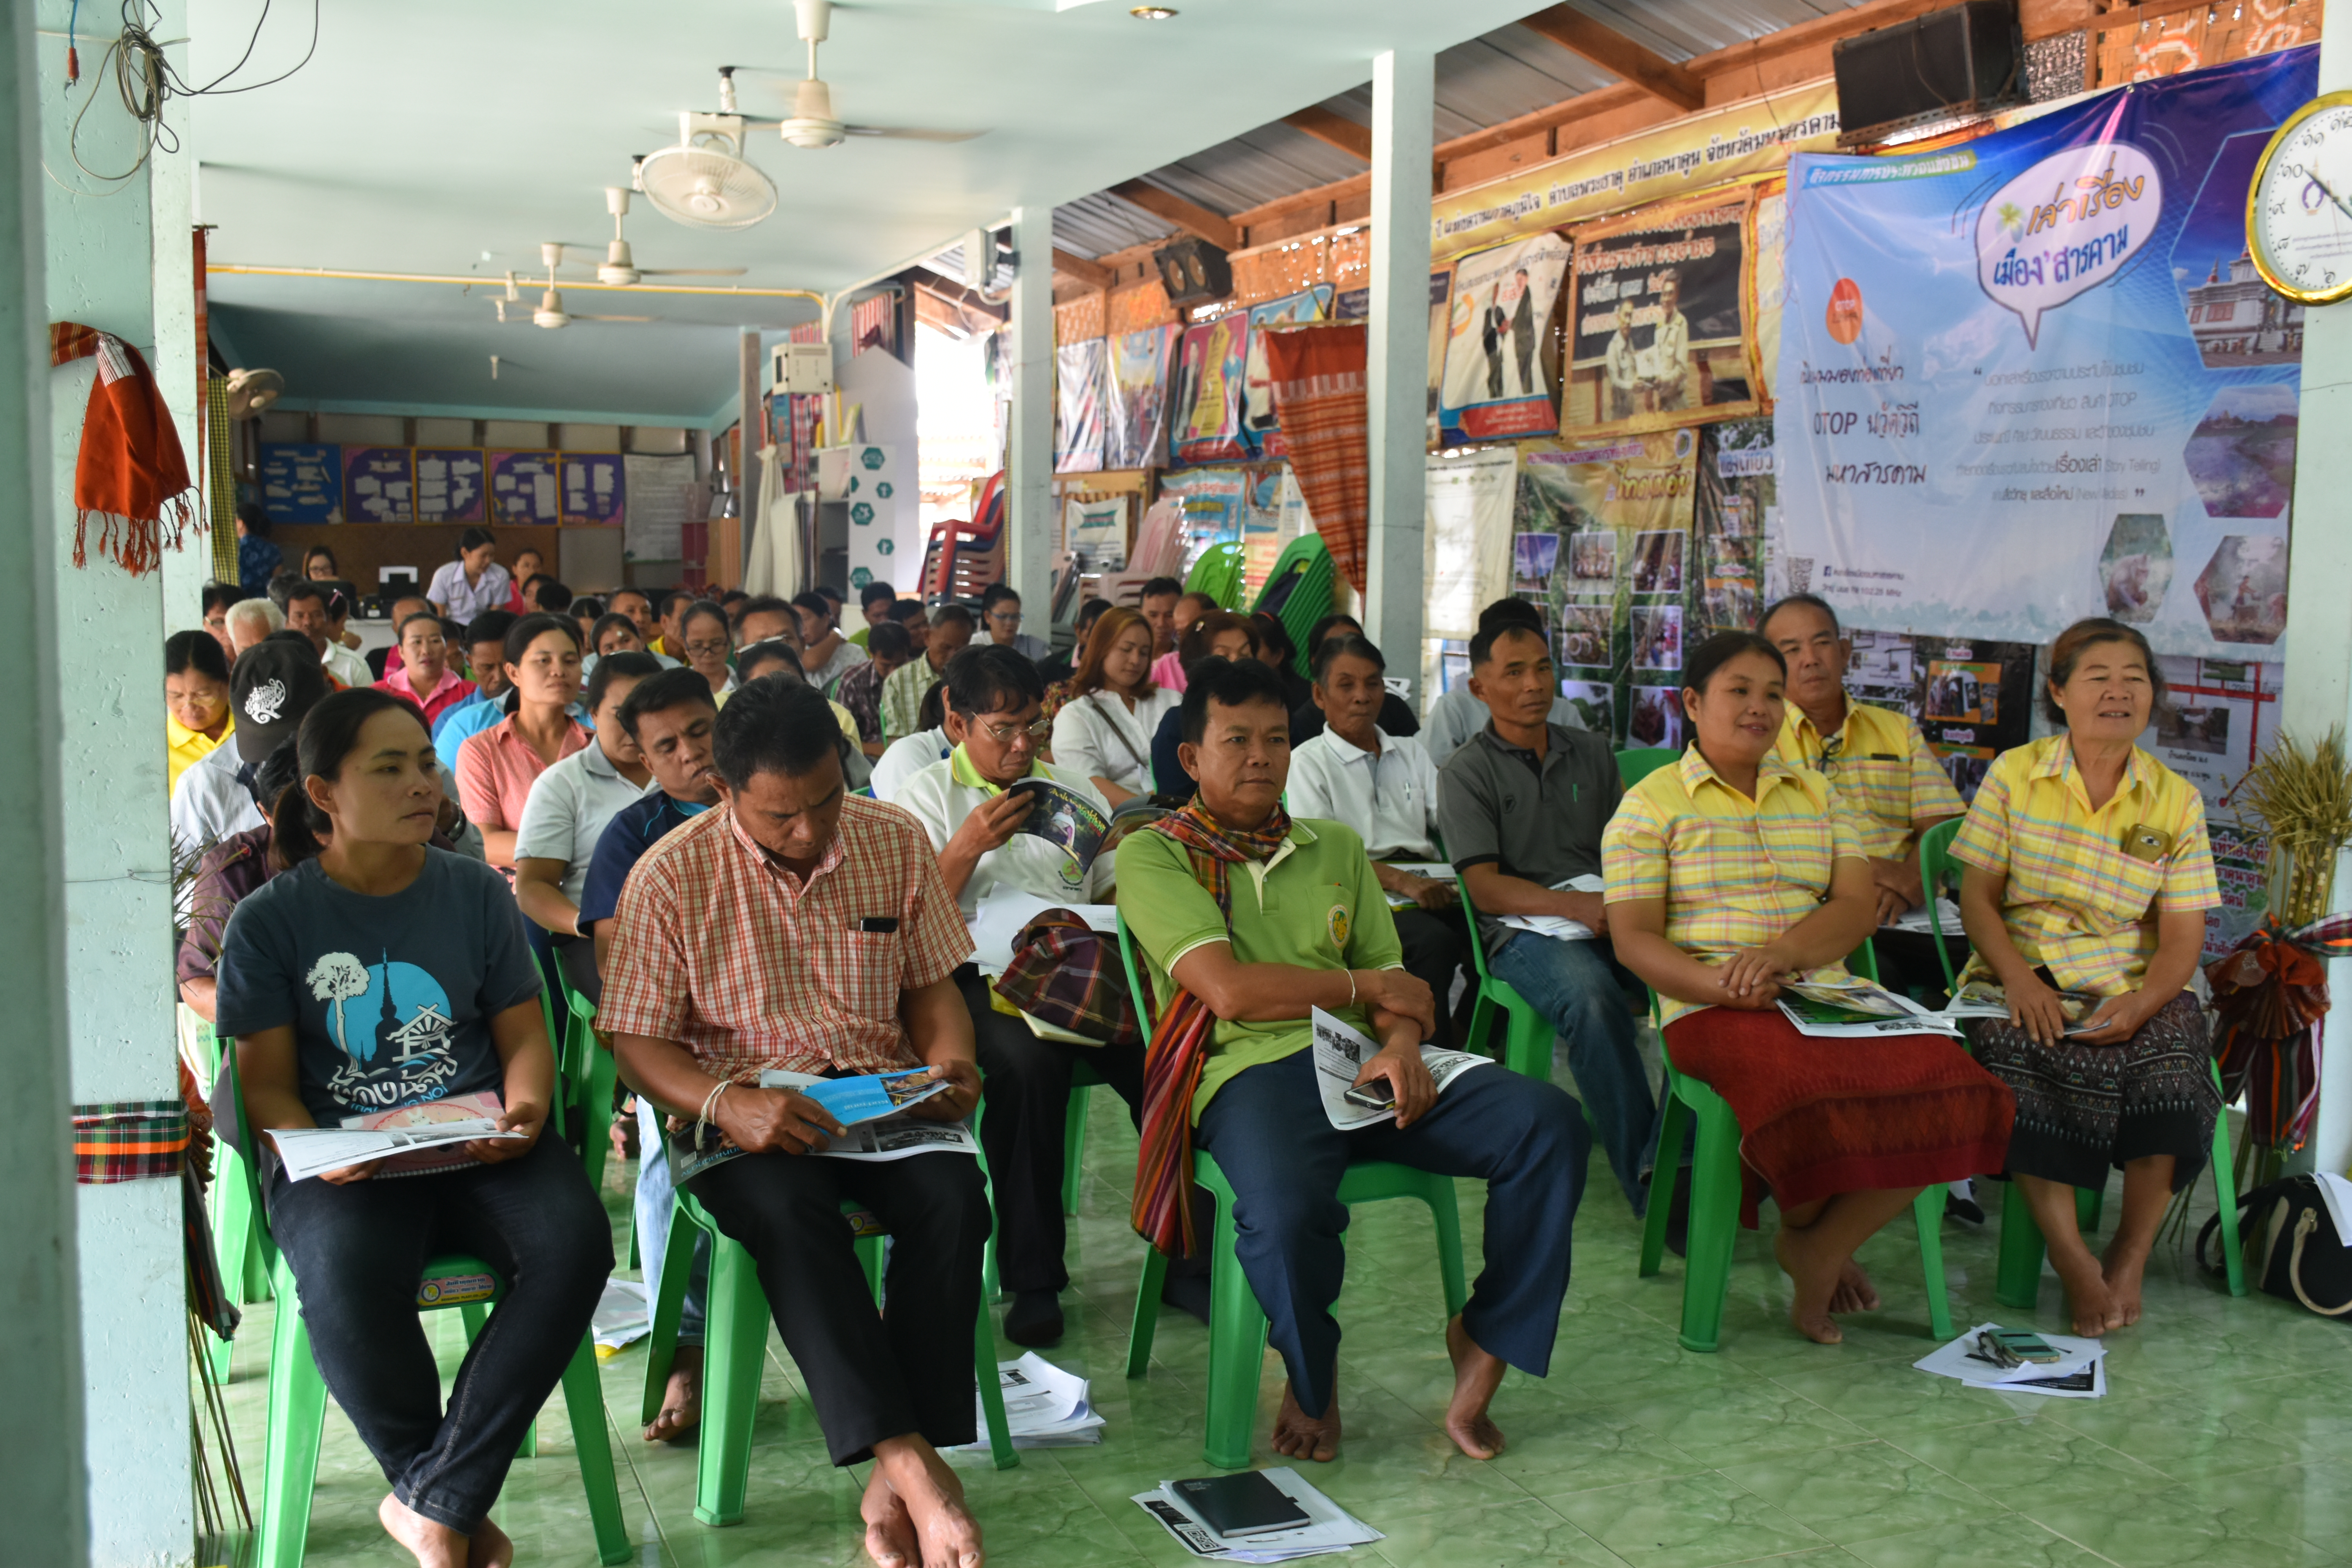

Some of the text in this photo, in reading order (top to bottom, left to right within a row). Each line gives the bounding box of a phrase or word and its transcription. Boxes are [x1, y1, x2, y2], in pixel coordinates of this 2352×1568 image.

[2027, 151, 2144, 236] เล่าเรื่อง
[1814, 411, 1858, 435] OTOP
[1826, 461, 1927, 485] มหาสารคาม
